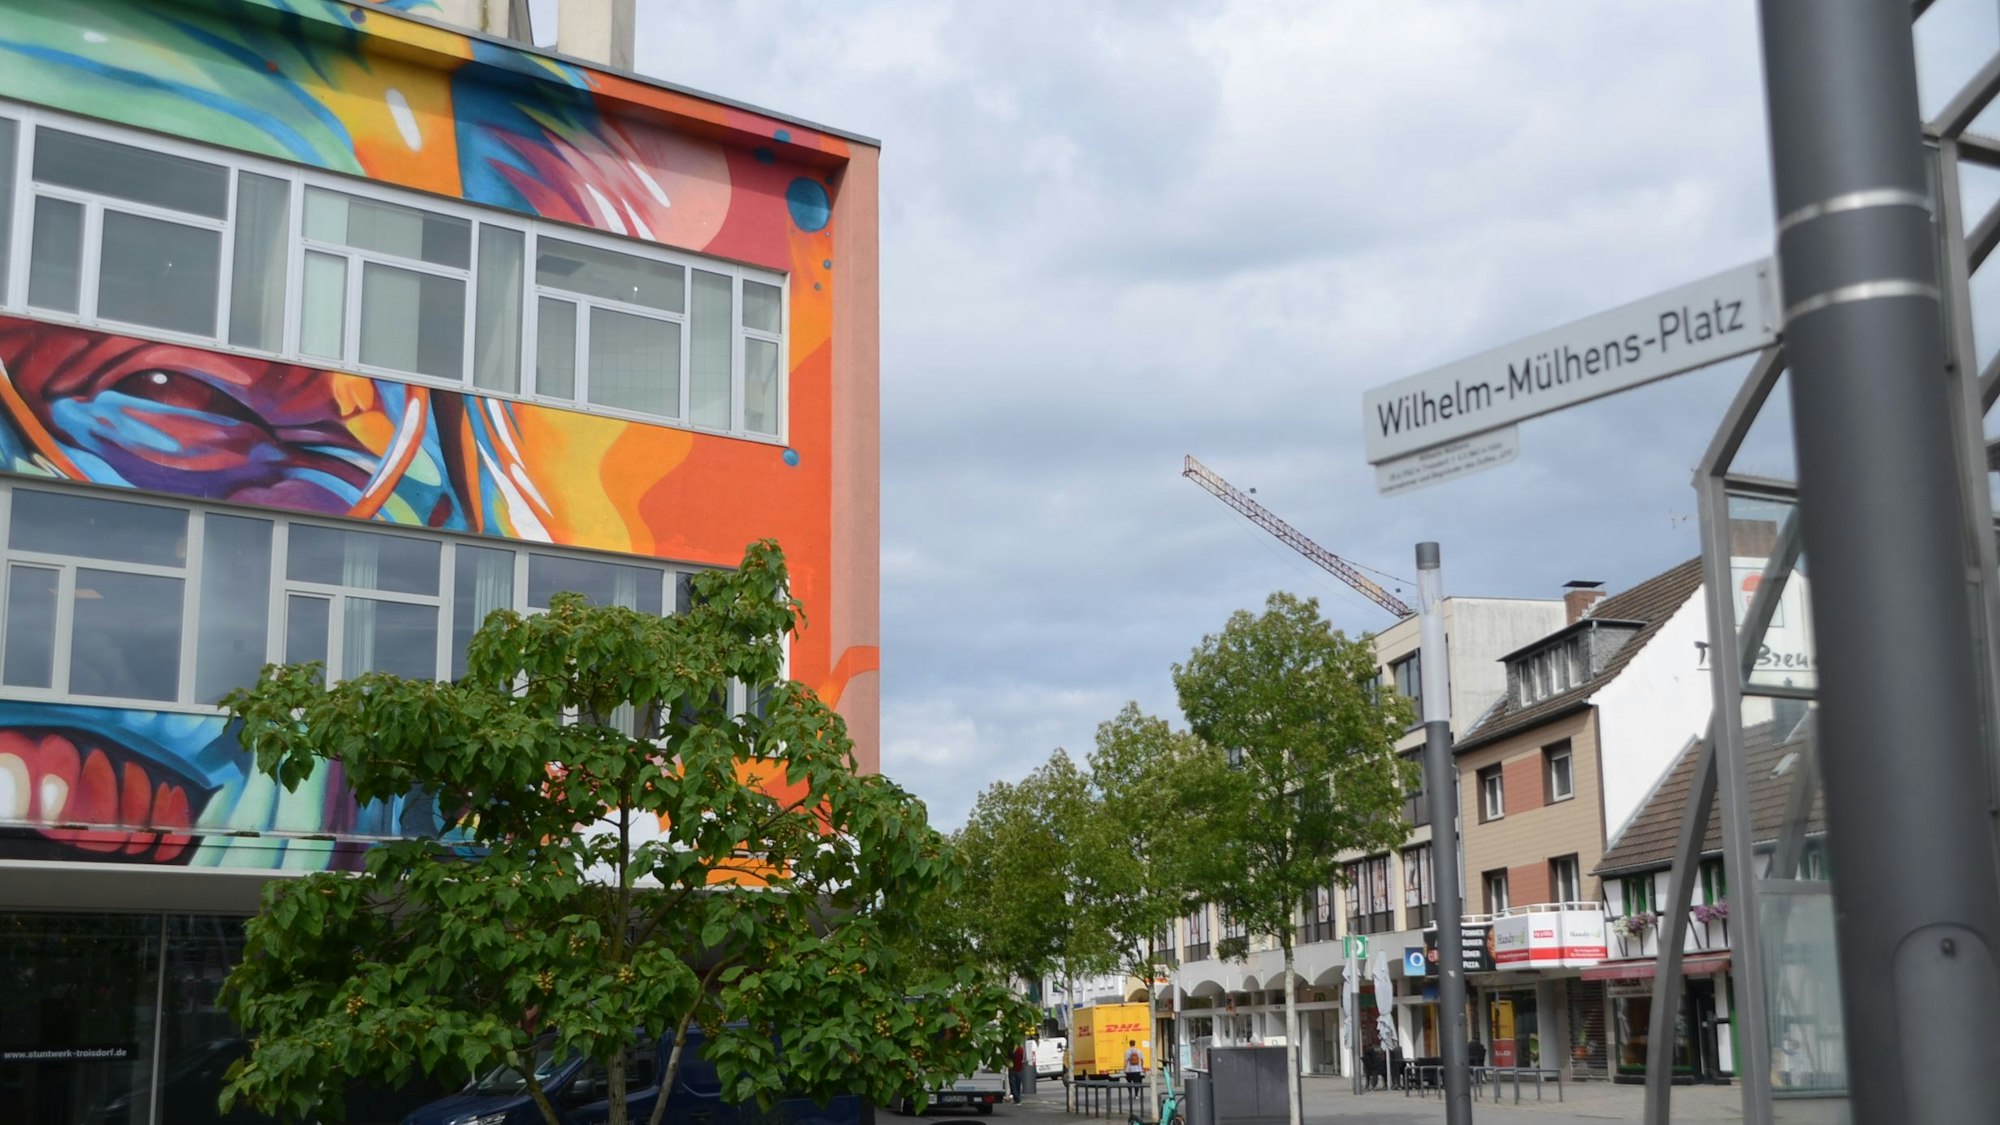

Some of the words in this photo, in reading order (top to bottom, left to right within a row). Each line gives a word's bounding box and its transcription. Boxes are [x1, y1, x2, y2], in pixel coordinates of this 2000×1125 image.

[1378, 299, 1743, 437] Wilhelm-Mülhens-Platz
[1462, 960, 1480, 969] PIZZA
[1104, 1023, 1142, 1033] DHL
[3, 1048, 128, 1059] www.stuntwerk-troisdorf.de
